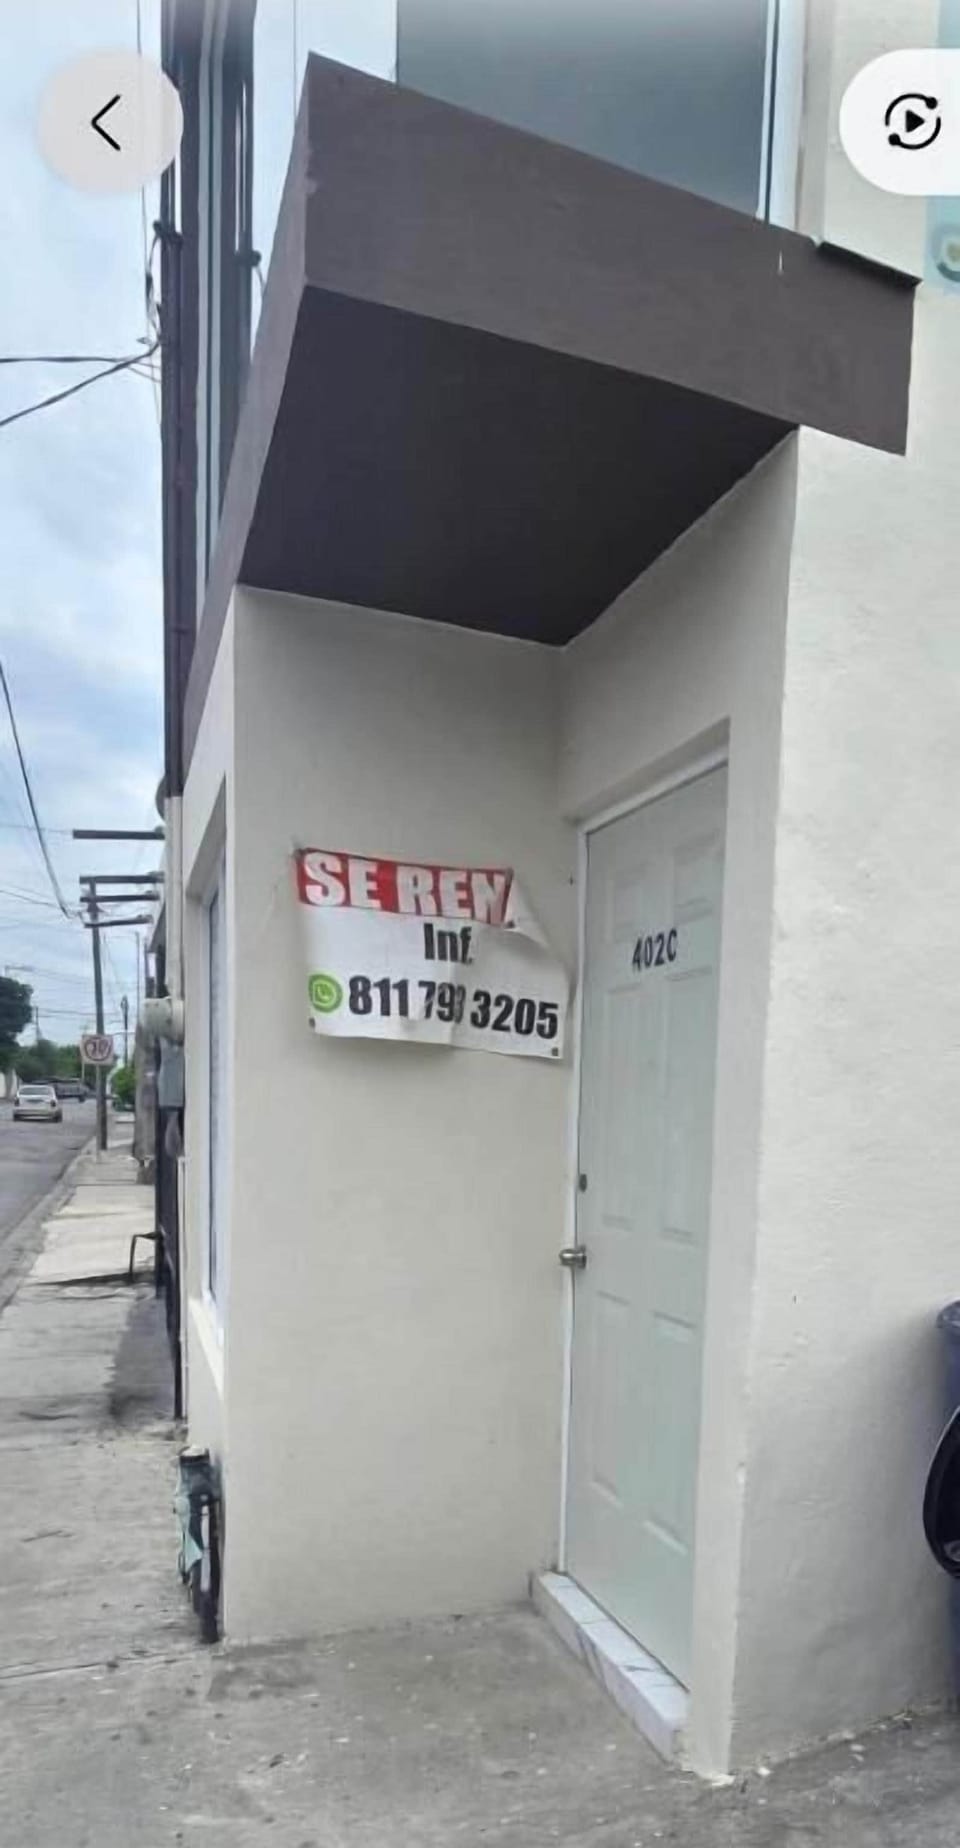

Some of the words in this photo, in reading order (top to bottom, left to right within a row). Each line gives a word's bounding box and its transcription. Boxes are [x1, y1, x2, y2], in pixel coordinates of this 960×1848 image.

[304, 851, 382, 909] SE
[632, 927, 677, 972] 402C
[348, 975, 409, 1018] 811
[470, 990, 560, 1040] 3205
